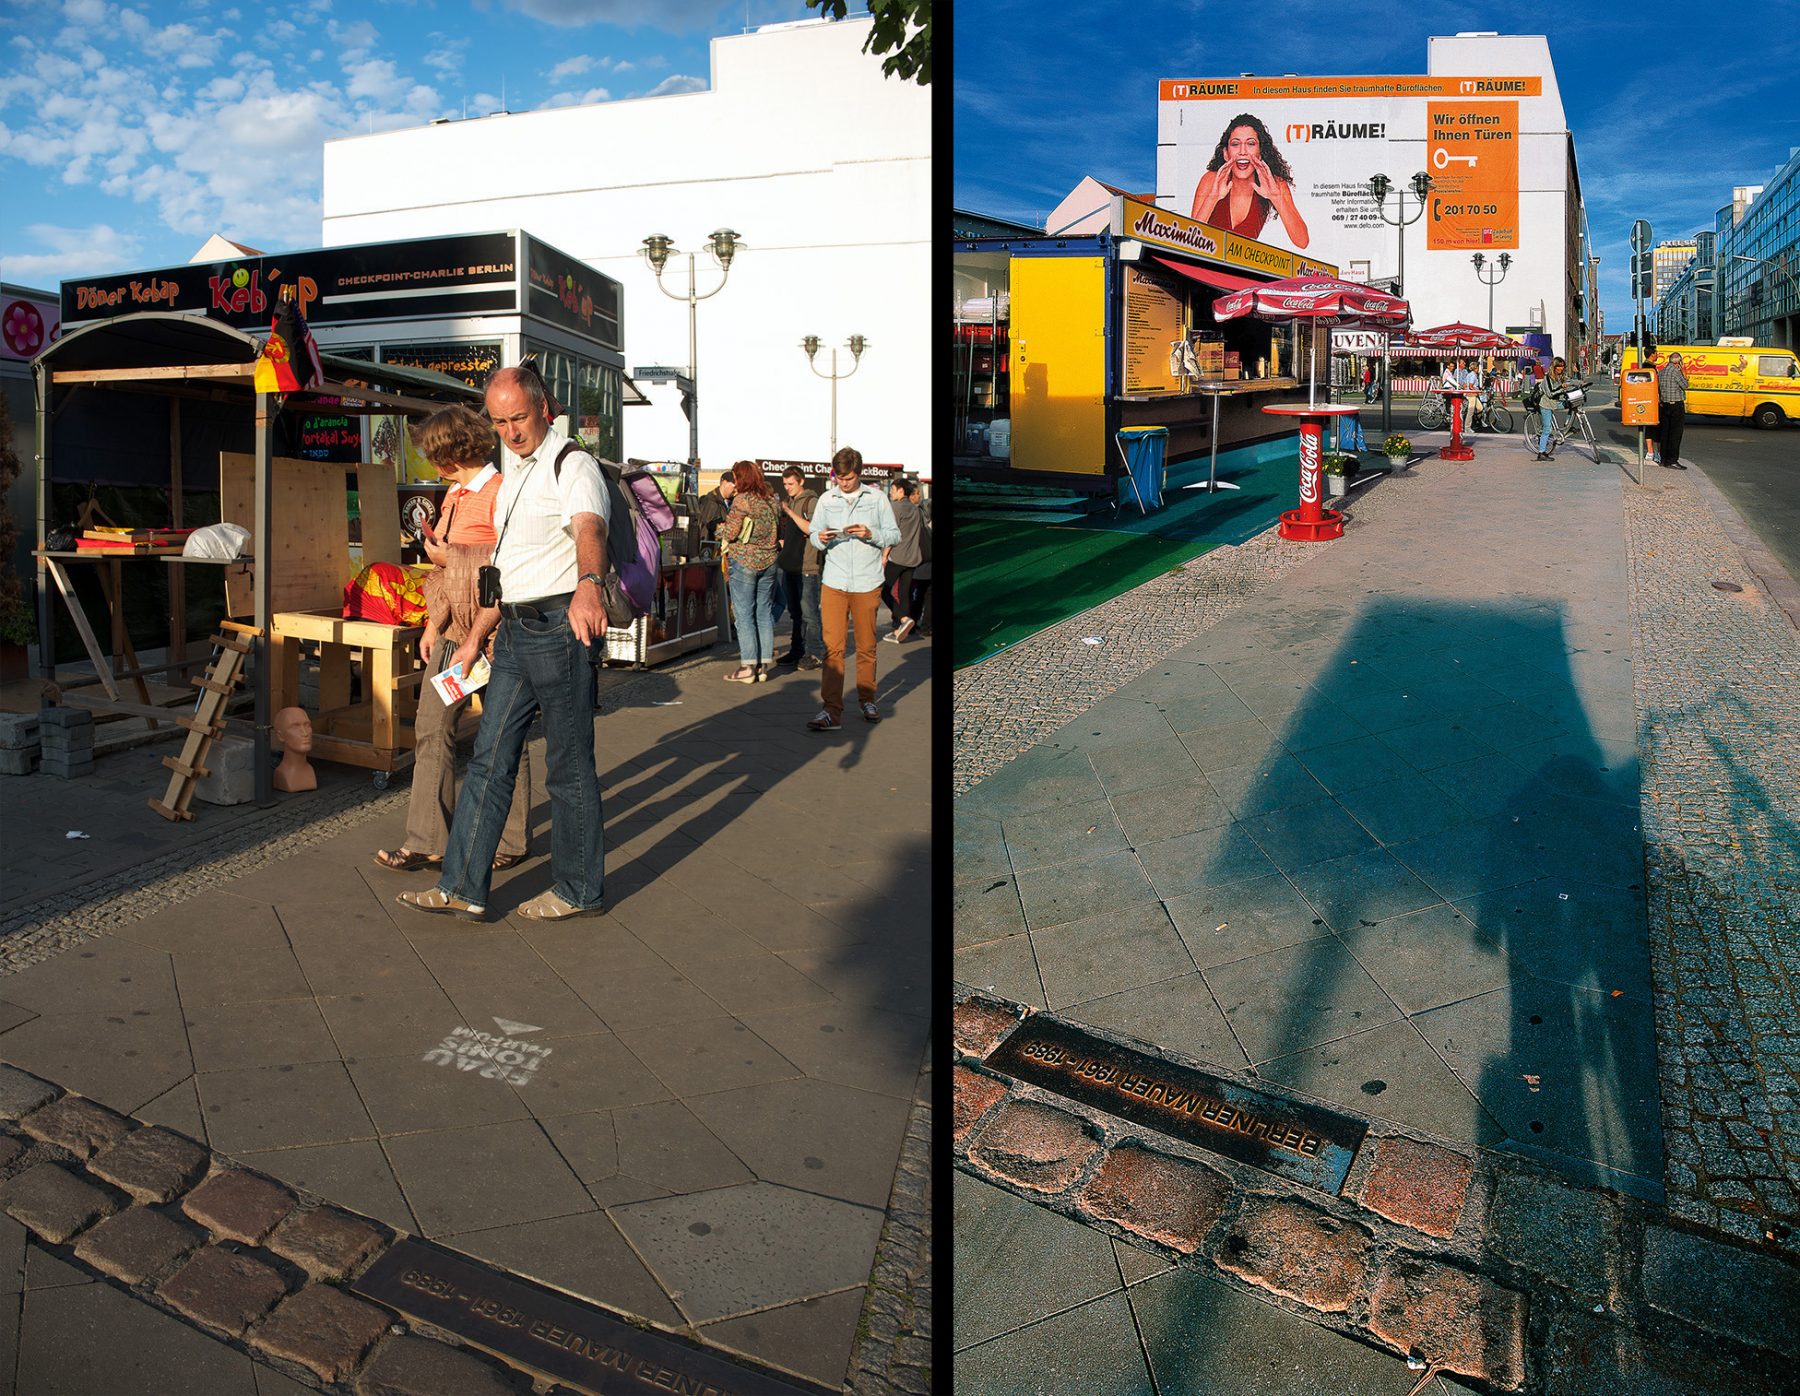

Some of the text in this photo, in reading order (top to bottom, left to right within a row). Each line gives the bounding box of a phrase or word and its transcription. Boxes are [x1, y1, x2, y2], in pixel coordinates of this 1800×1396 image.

[1262, 86, 1289, 94] diesem
[1313, 85, 1337, 93] finden
[1339, 85, 1351, 93] Sie
[1353, 84, 1394, 93] traumhafte
[1433, 114, 1500, 125] Wir öffnen
[1286, 120, 1386, 143] (T)RÄUME!
[1433, 129, 1512, 140] Ihnen Türen
[1445, 205, 1497, 215] 201 70 50
[1135, 211, 1217, 254] Maximilian
[1226, 242, 1242, 258] AM
[1243, 247, 1291, 270] CHECKPOINT
[337, 263, 514, 286] CHECKPOINT-CHARLIE BERLIN
[76, 277, 180, 311] Döner Kebap
[303, 430, 361, 447] ortakal Suy
[1118, 1072, 1201, 1116] MAUER
[1200, 1101, 1322, 1159] BERLINER
[528, 1319, 633, 1373] MAUER
